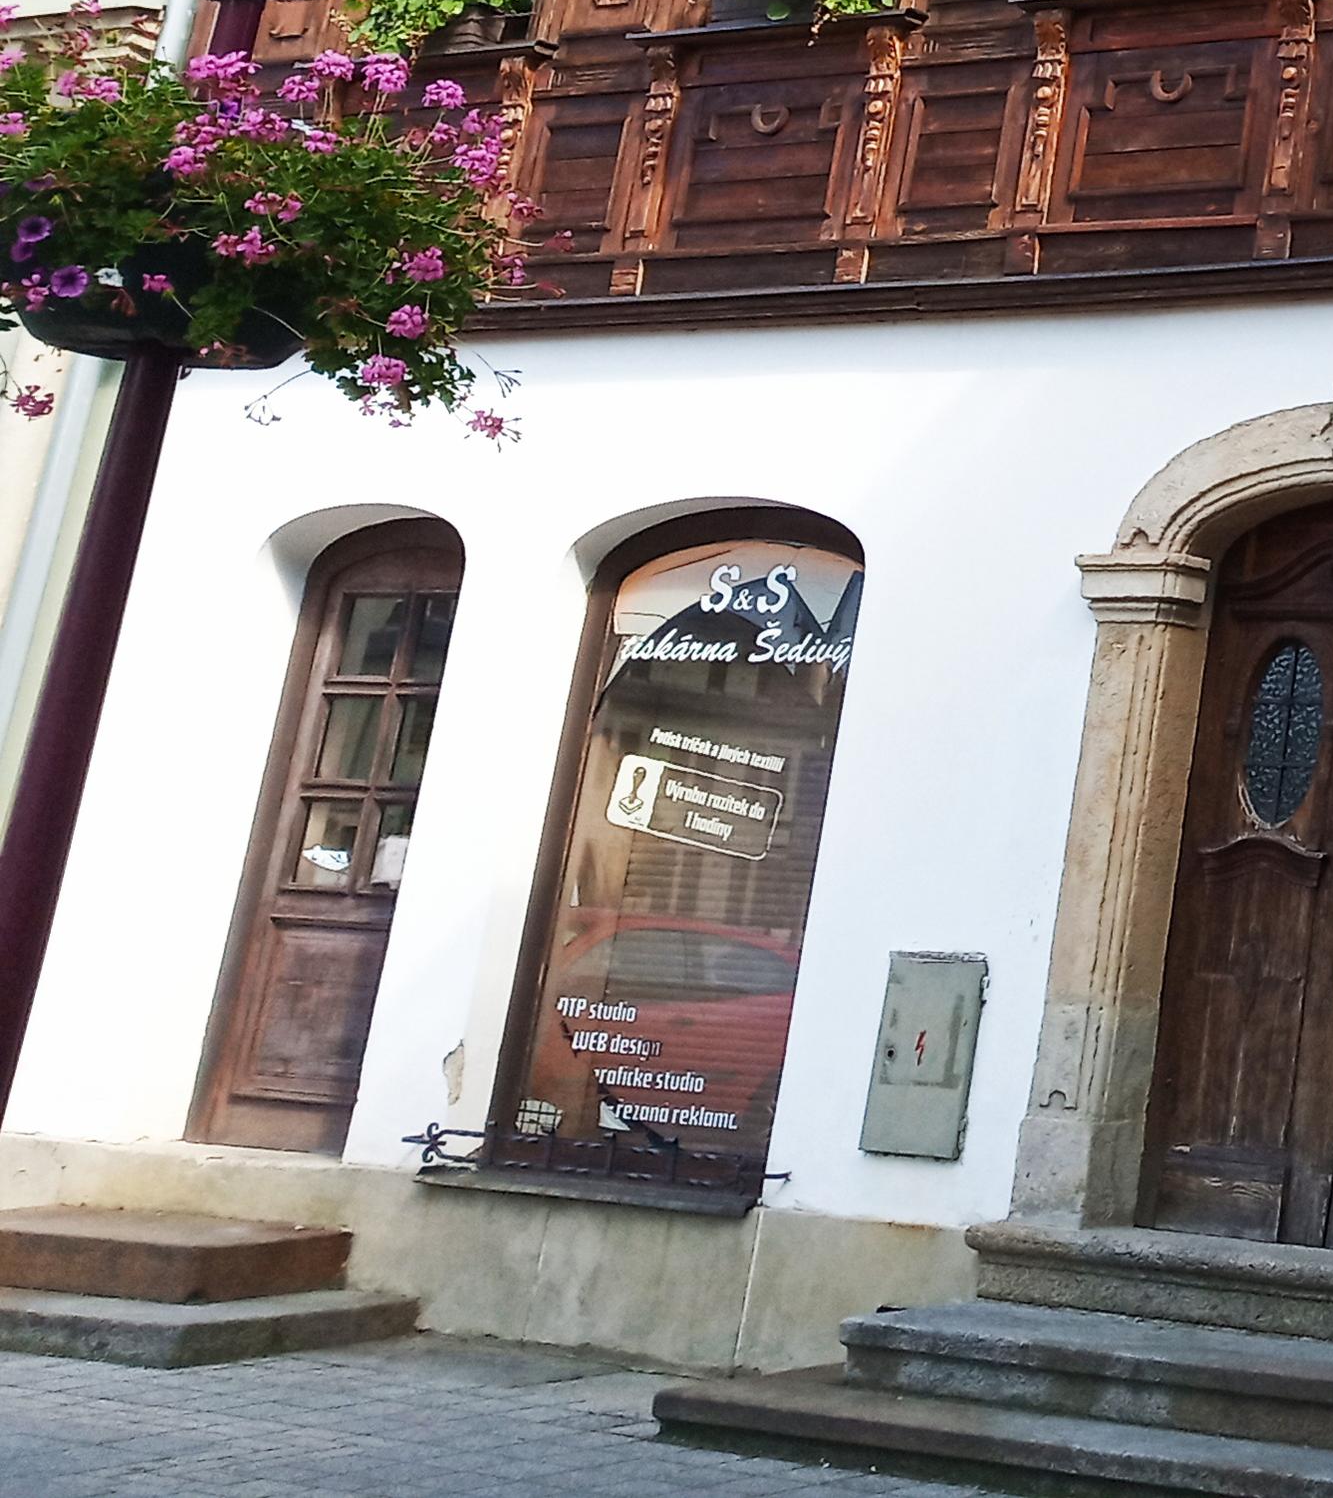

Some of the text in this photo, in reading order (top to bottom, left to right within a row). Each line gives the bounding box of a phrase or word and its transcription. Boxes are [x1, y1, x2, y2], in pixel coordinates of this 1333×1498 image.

[700, 562, 797, 615] S&S
[620, 621, 853, 673] tiskárna Šedivý
[665, 779, 708, 805] Výroba
[748, 802, 765, 820] do
[685, 811, 733, 841] 1 hodiny
[588, 1001, 637, 1022] studio
[571, 1031, 662, 1061] WEB design
[655, 1067, 705, 1093] studio
